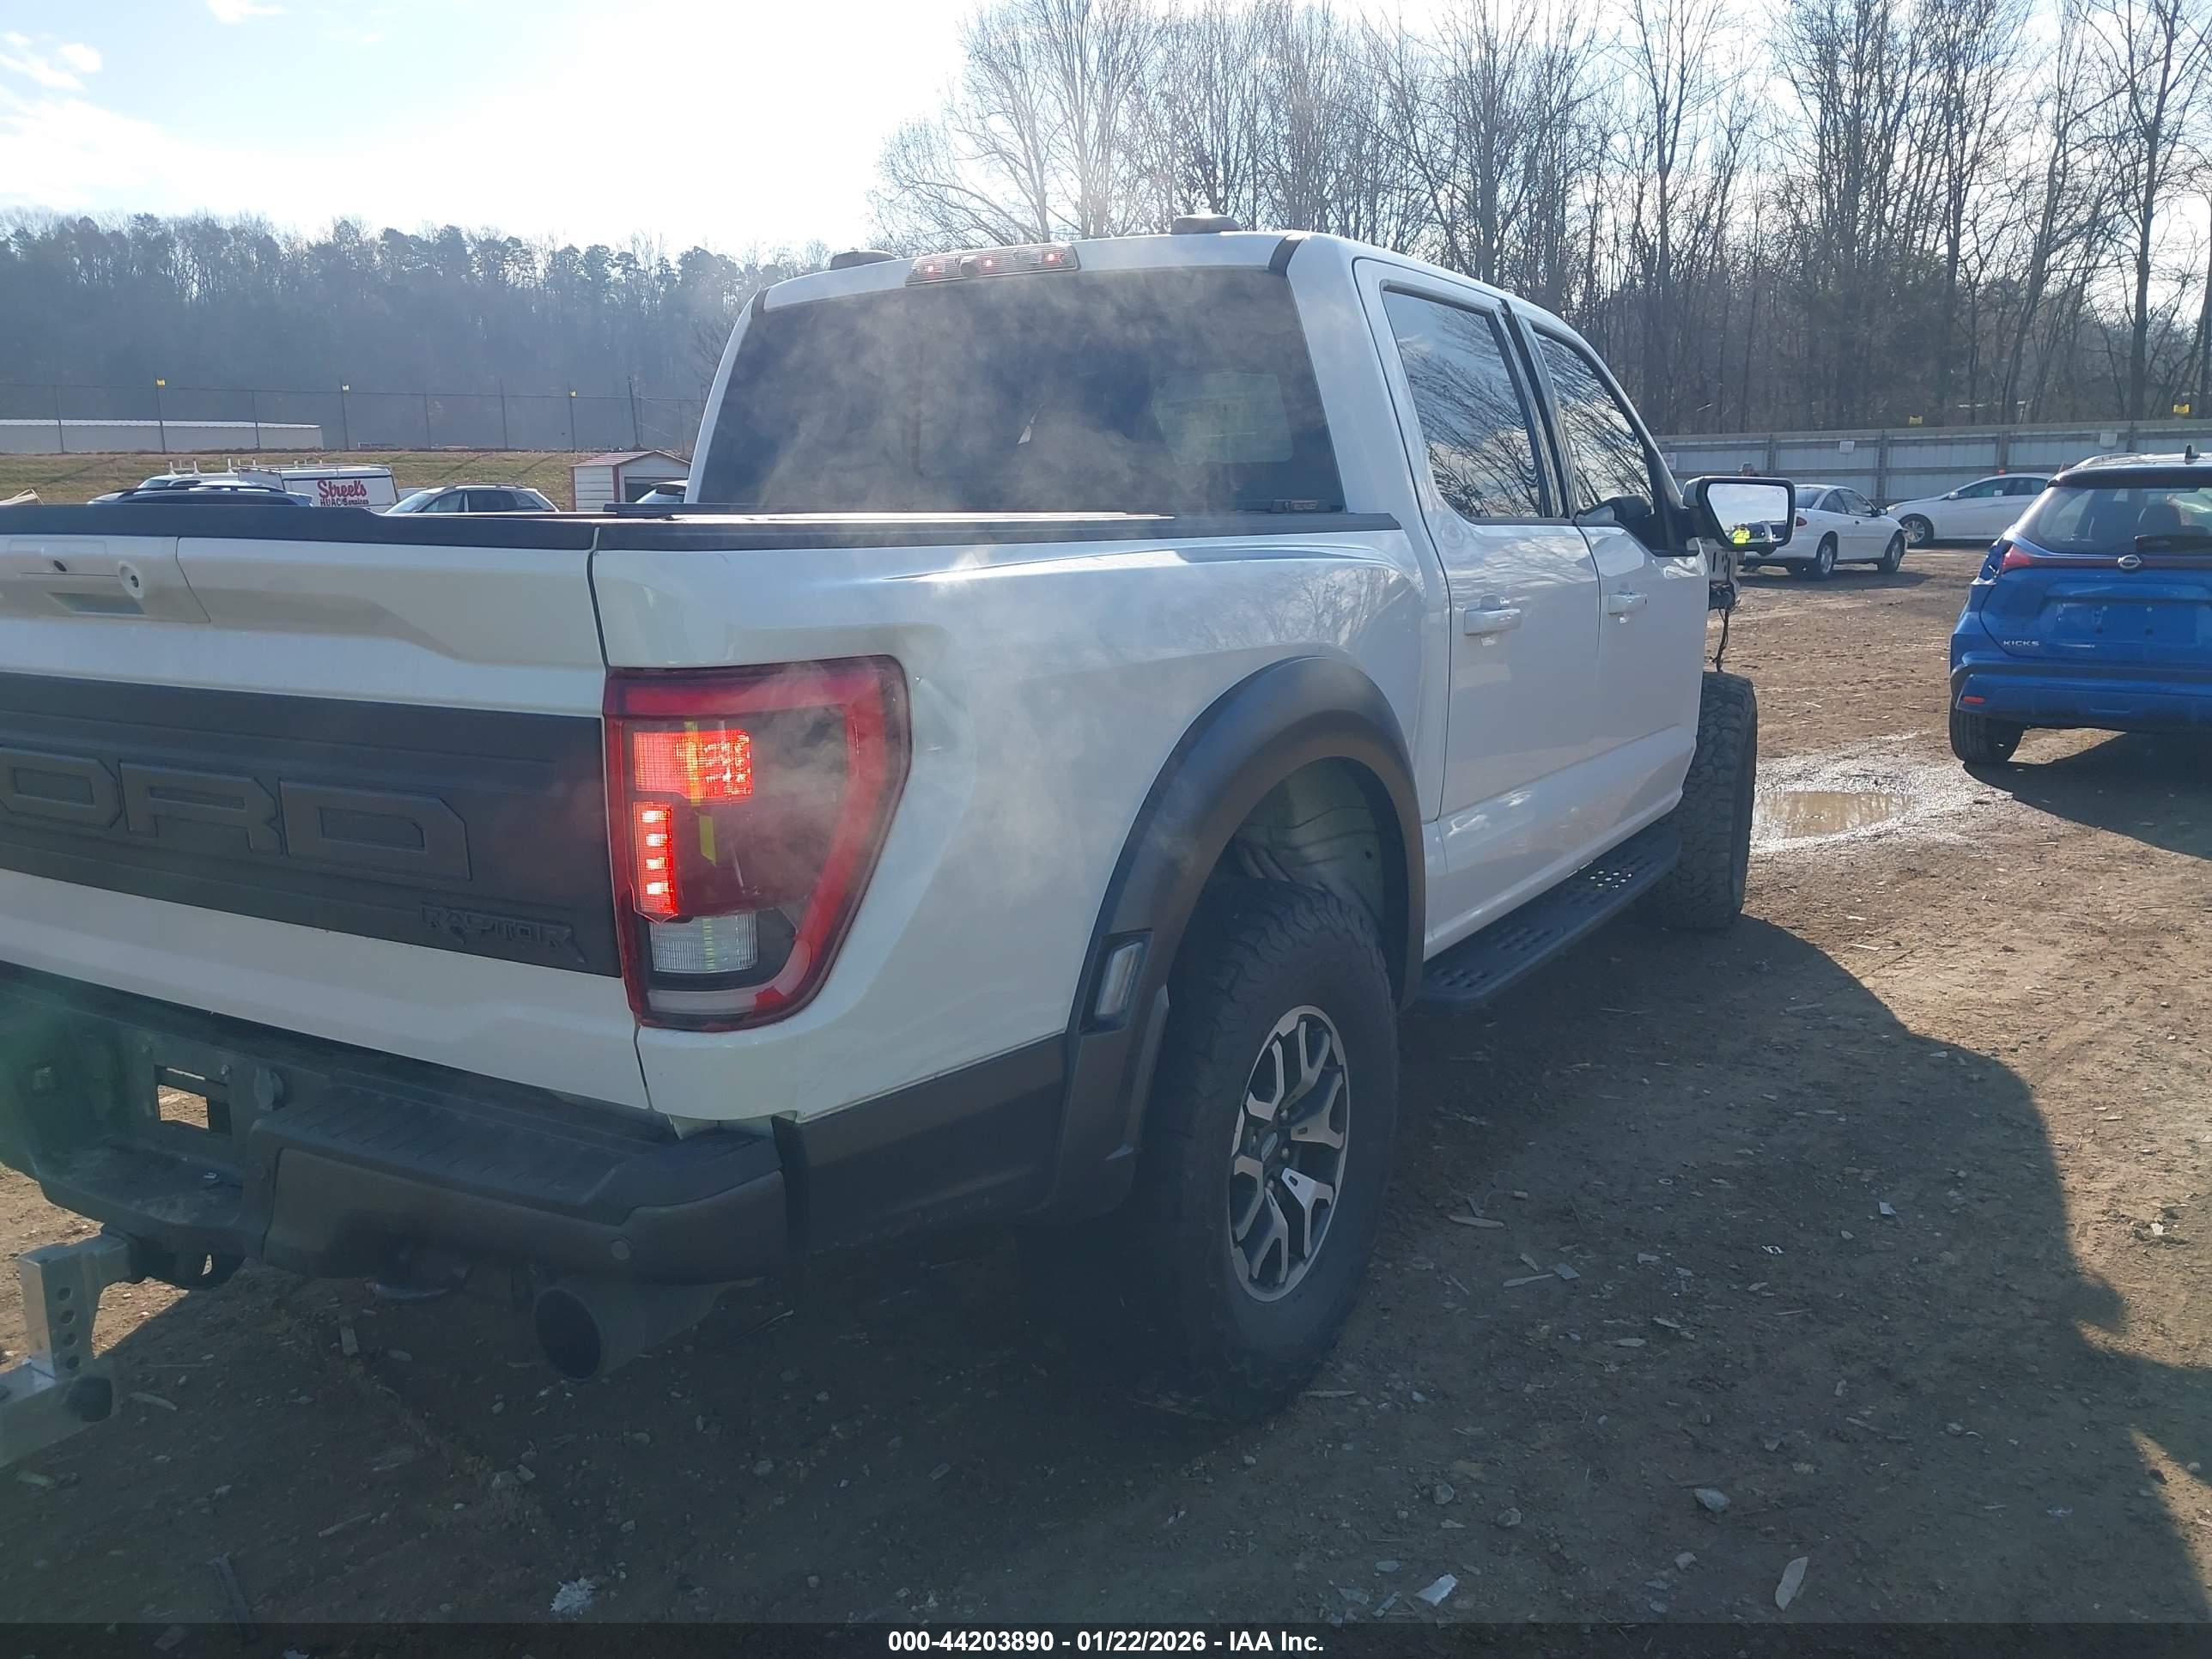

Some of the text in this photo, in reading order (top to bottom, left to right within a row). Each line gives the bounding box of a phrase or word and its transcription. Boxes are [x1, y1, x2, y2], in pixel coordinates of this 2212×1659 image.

[317, 479, 367, 498] Street's
[319, 498, 342, 507] HVAC
[419, 908, 588, 963] RAPTOR
